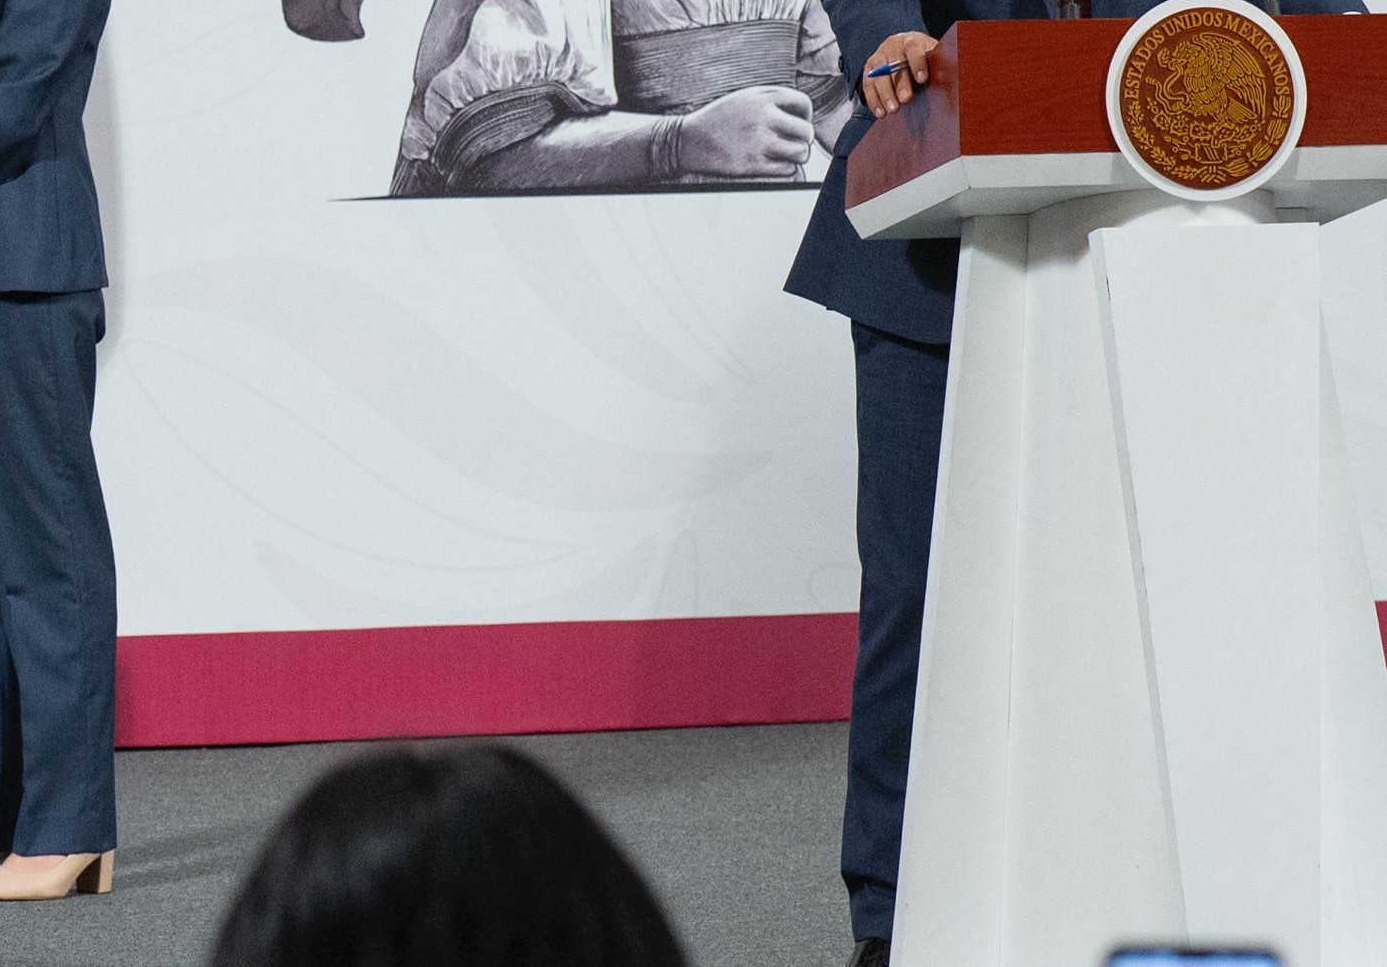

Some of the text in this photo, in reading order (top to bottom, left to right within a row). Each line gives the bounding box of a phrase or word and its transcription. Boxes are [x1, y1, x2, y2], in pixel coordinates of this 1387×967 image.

[1124, 12, 1290, 99] ESTADOS UNIDOS MEXICANOS
